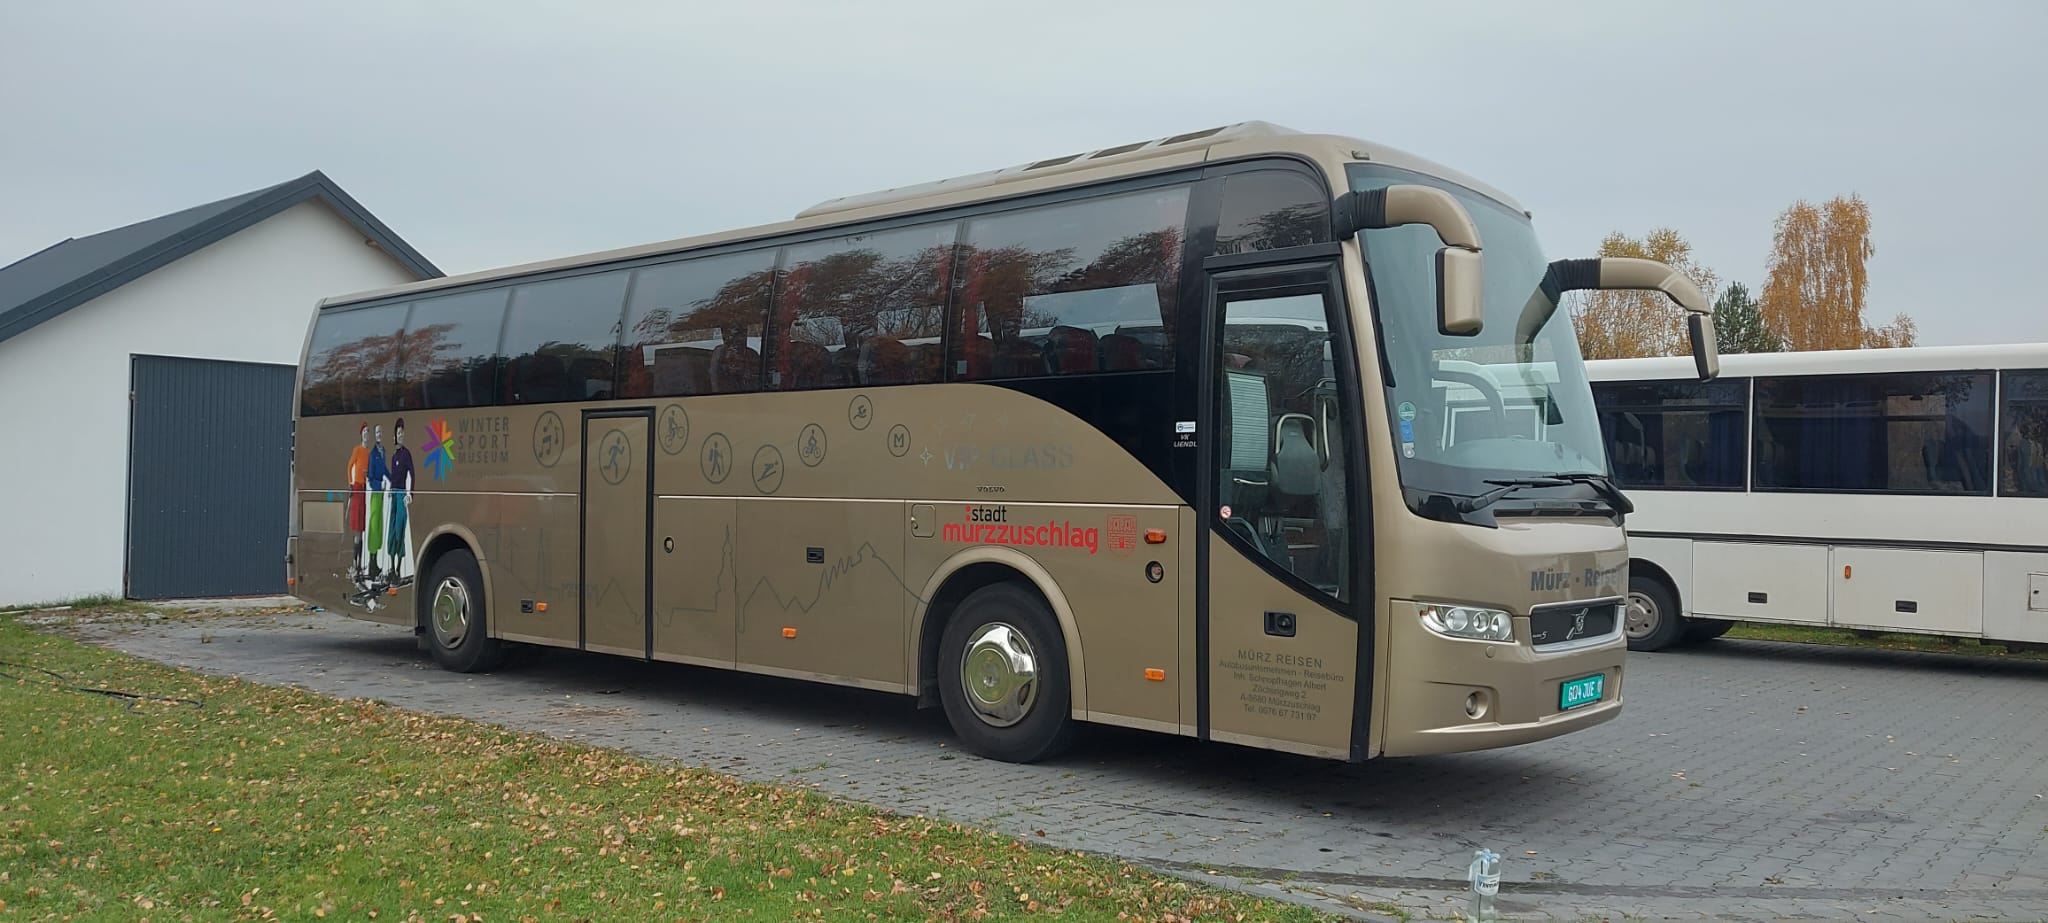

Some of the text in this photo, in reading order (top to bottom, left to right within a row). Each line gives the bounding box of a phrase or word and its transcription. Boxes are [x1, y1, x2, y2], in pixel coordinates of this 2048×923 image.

[458, 416, 510, 433] WINTER
[458, 434, 510, 450] SPORT
[458, 450, 509, 464] MUSEUM
[976, 485, 1005, 493] VOLVO
[1531, 568, 1569, 592] Mürz
[1238, 649, 1322, 669] MÜRZ REISEN
